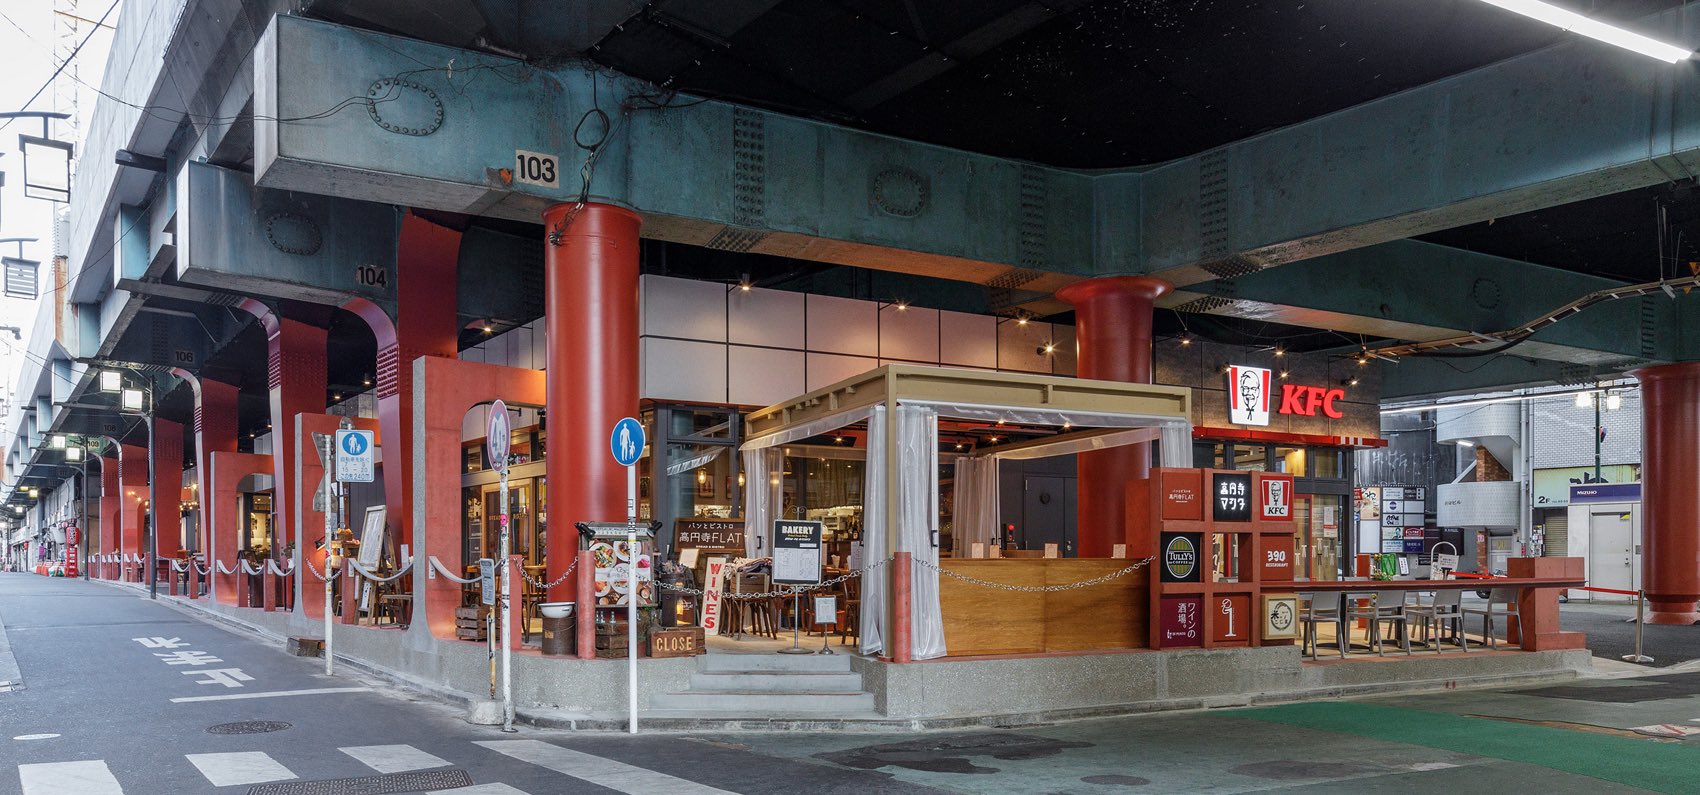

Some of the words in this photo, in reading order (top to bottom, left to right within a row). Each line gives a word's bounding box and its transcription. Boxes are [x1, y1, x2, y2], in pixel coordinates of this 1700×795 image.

[518, 154, 556, 183] 103
[358, 266, 387, 288] 104
[176, 350, 194, 363] 106
[1279, 383, 1345, 419] KFC
[1219, 482, 1246, 496] 高円寺
[1267, 506, 1285, 515] KFC
[688, 522, 734, 530] パンとビストロ
[781, 525, 814, 535] BAKERY
[679, 531, 742, 543] 高円寺FLAT
[1267, 550, 1286, 562] 390
[704, 563, 722, 629] WINES
[1177, 602, 1187, 629] 酒場。
[1187, 602, 1196, 639] ワインの
[656, 636, 692, 652] CLOSE
